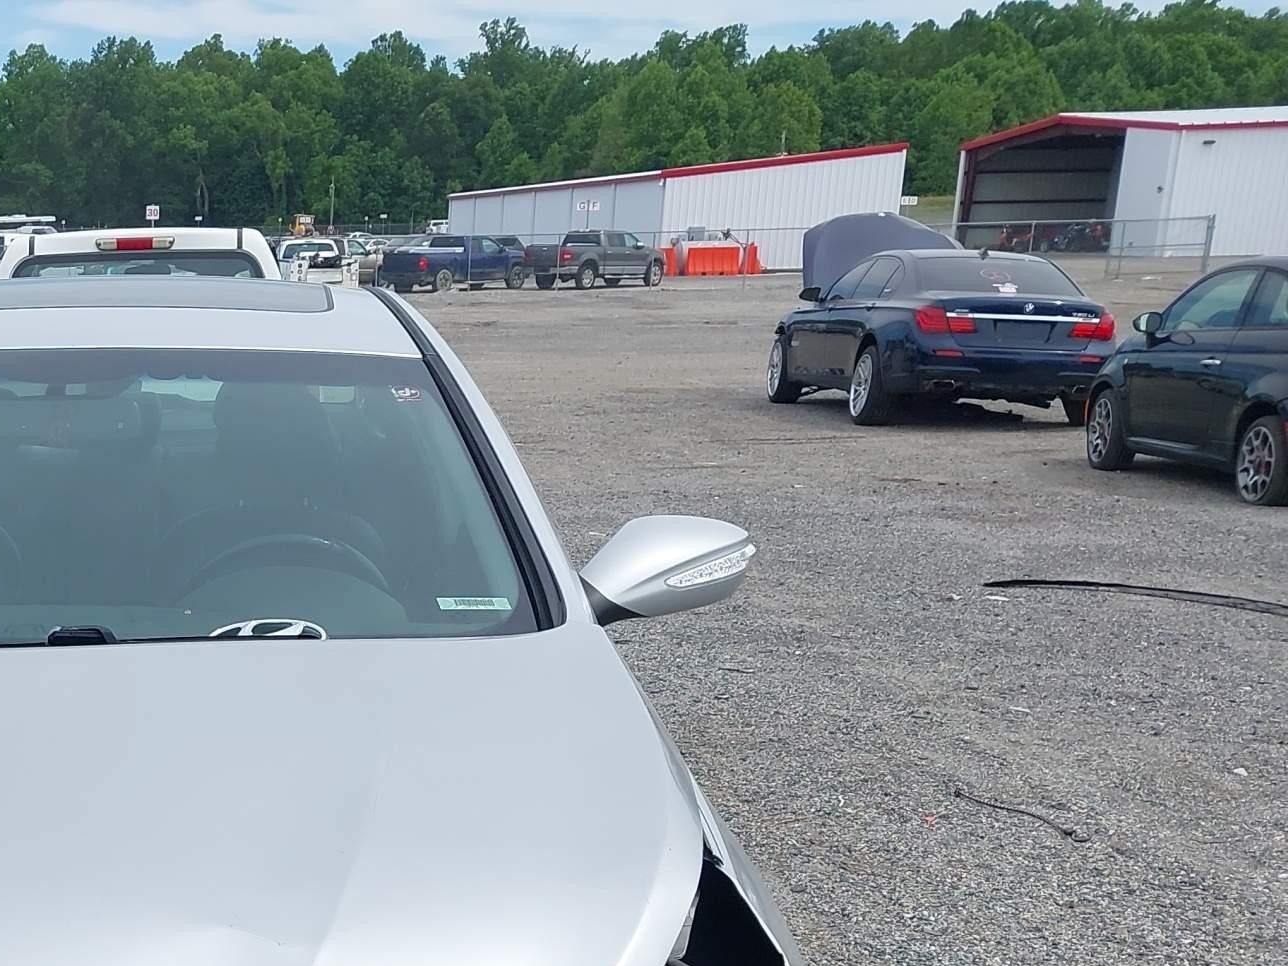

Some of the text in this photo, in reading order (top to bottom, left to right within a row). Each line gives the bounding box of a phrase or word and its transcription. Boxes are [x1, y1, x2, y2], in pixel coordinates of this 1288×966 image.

[578, 201, 599, 210] G F
[147, 208, 159, 217] 30
